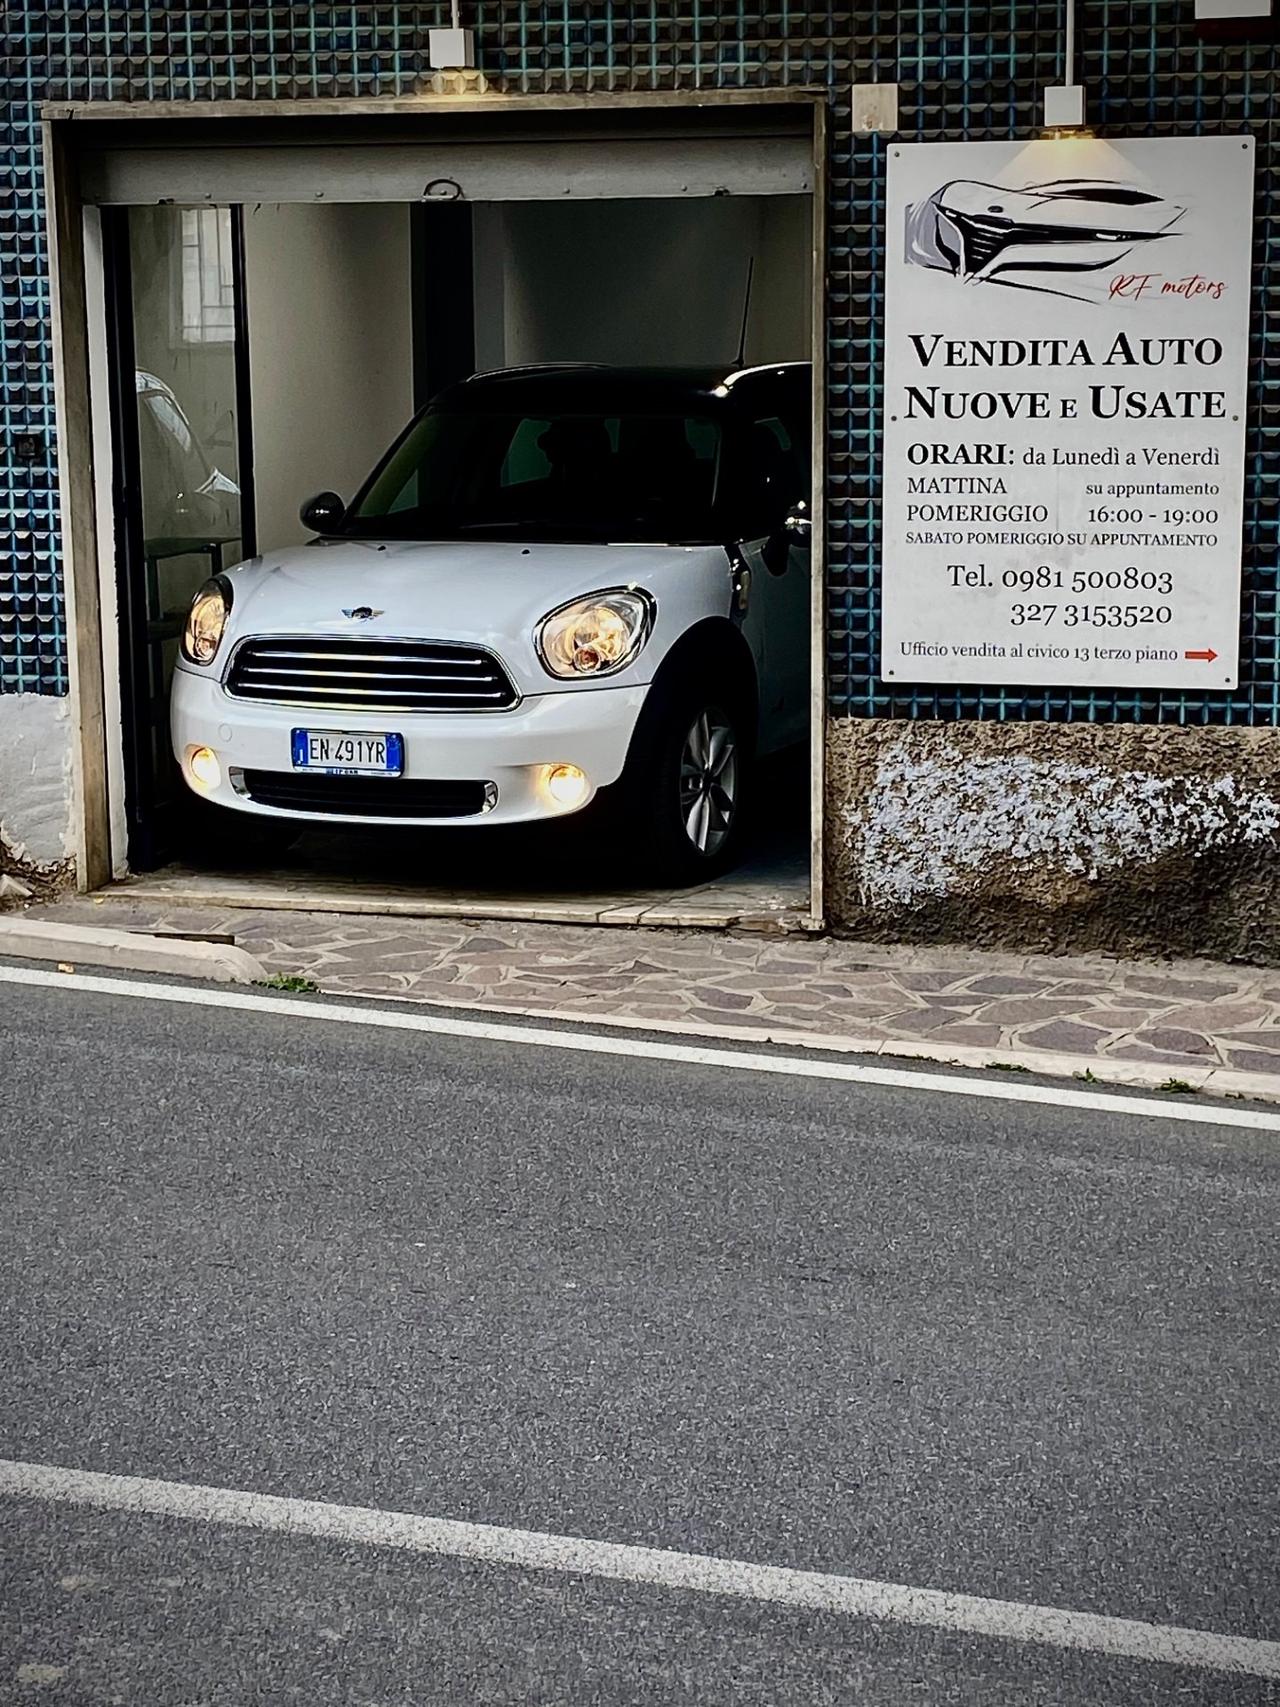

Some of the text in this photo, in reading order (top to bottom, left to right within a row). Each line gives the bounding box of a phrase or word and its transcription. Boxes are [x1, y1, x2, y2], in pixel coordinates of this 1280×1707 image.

[1109, 274, 1227, 300] RF motors
[908, 331, 1223, 367] VENDITA AUTO
[904, 385, 1226, 419] NUOVE E USATE
[907, 443, 1220, 466] ORARI: da Lunedì a Venerdì
[907, 477, 1220, 498] MATTINA su appuntamento
[907, 504, 1049, 522] POMERIGGIO
[1089, 506, 1143, 523] 16:00
[1163, 509, 1219, 526] 19:00
[906, 532, 1218, 546] SABATO POMERIGGIO SU APPUNTAMENTO
[947, 564, 1173, 594] Tel. 0981 500803
[1010, 604, 1172, 627] 327 3153520
[900, 641, 1178, 663] Ufficio vendita al civico 13 terzo piano
[310, 738, 329, 761] EN
[335, 740, 385, 763] 491YR
